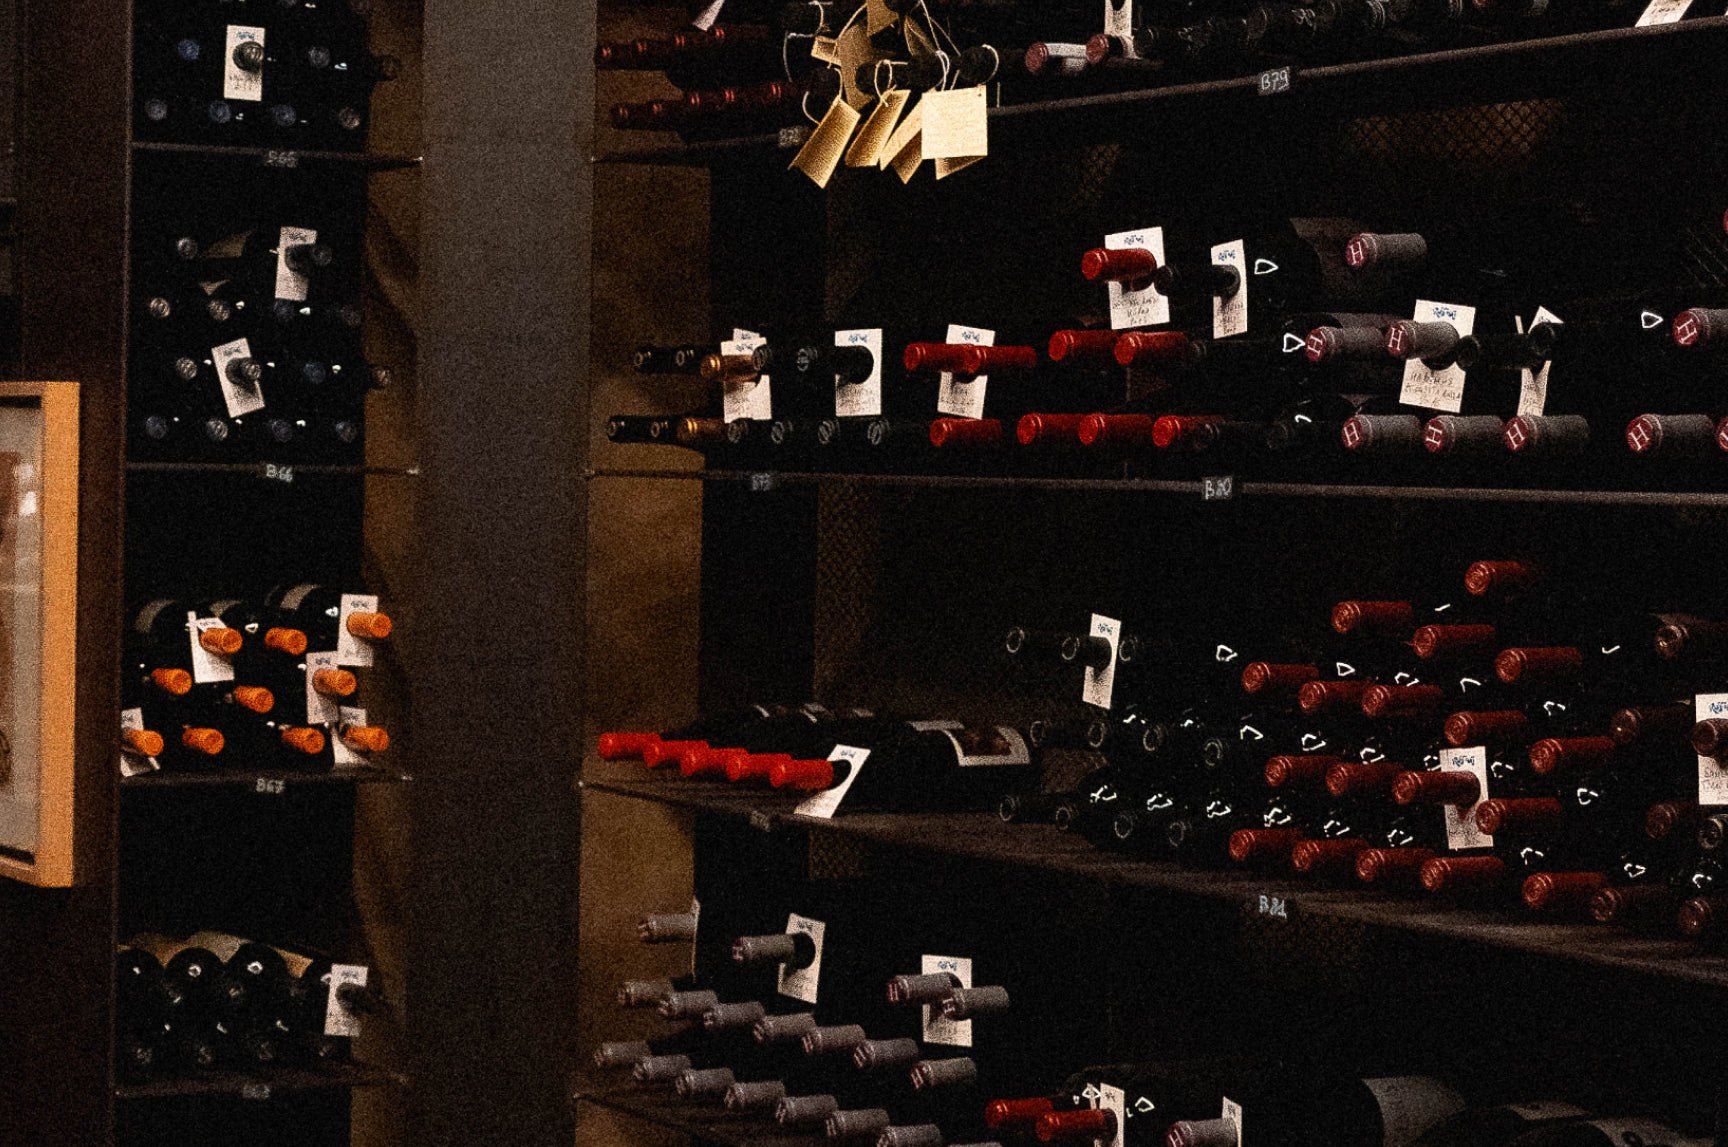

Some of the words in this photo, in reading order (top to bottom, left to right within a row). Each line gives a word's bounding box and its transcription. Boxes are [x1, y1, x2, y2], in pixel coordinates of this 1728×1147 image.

[1261, 66, 1290, 92] B79
[1349, 240, 1365, 261] H
[1387, 330, 1403, 352] H
[1676, 319, 1698, 345] H
[1307, 336, 1324, 357] H
[1343, 423, 1361, 447] H
[1425, 426, 1443, 445] H
[1506, 423, 1526, 448] H
[1628, 423, 1651, 451] H
[266, 463, 293, 484] B66
